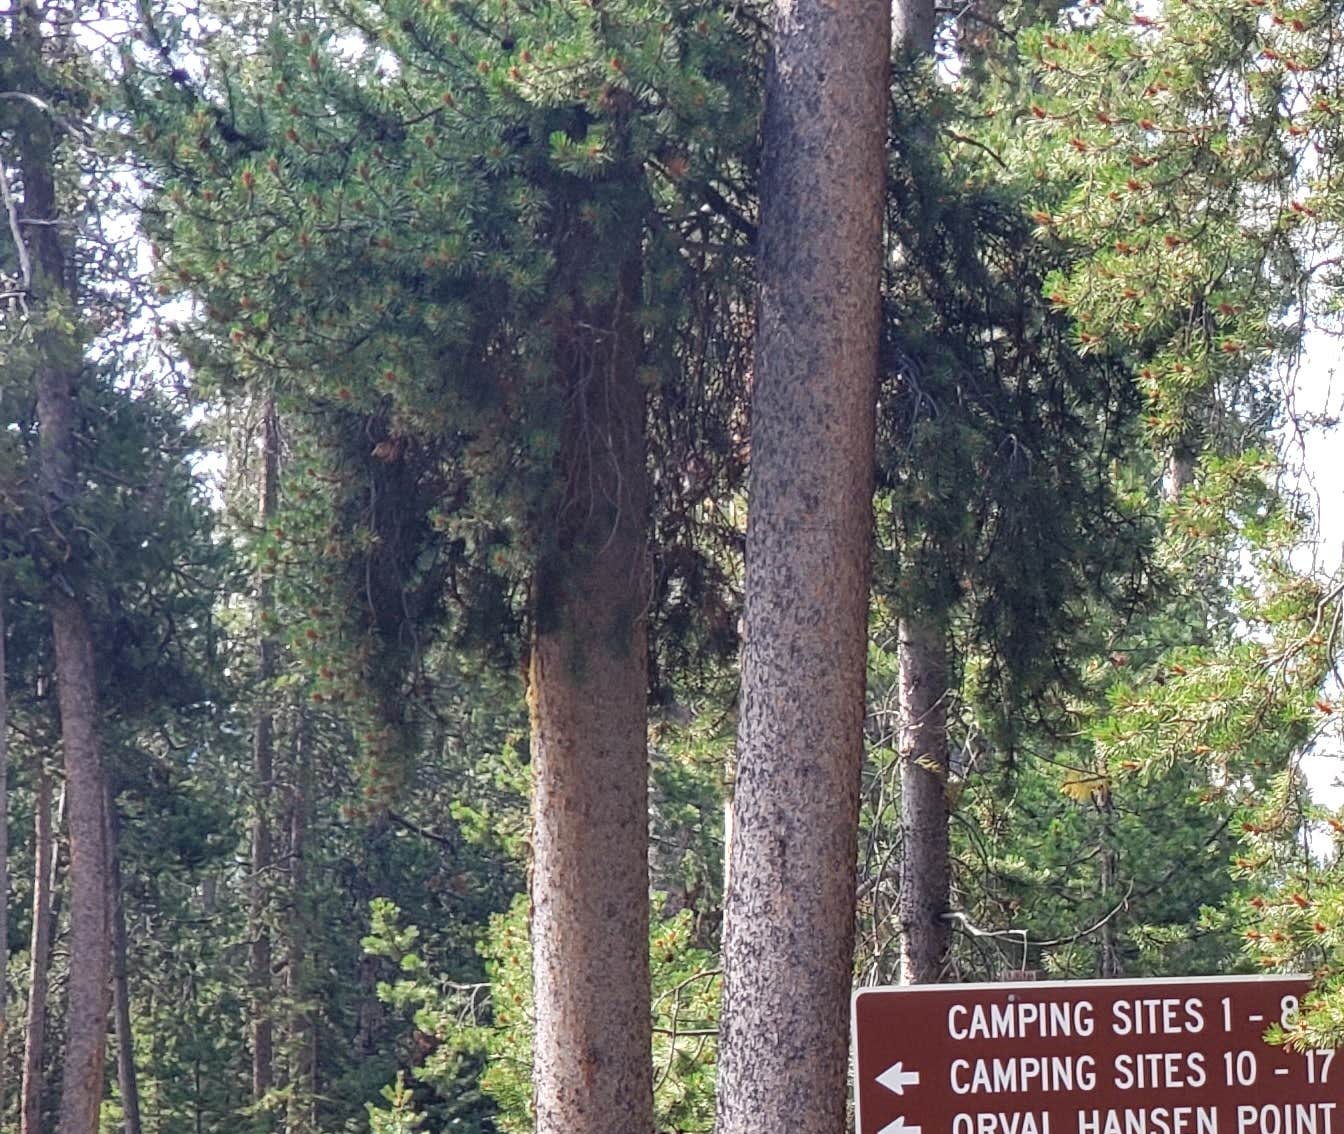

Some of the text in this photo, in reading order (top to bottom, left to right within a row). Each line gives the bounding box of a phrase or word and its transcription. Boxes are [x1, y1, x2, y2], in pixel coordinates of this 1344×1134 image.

[947, 998, 1094, 1041] CAMPING
[1112, 998, 1204, 1037] SITES
[1221, 997, 1231, 1032] 1
[1280, 994, 1300, 1031] 8
[949, 1056, 1096, 1095] CAMPING
[1114, 1052, 1207, 1091] SITES
[1223, 1050, 1257, 1086] 10
[1305, 1049, 1335, 1084] 17
